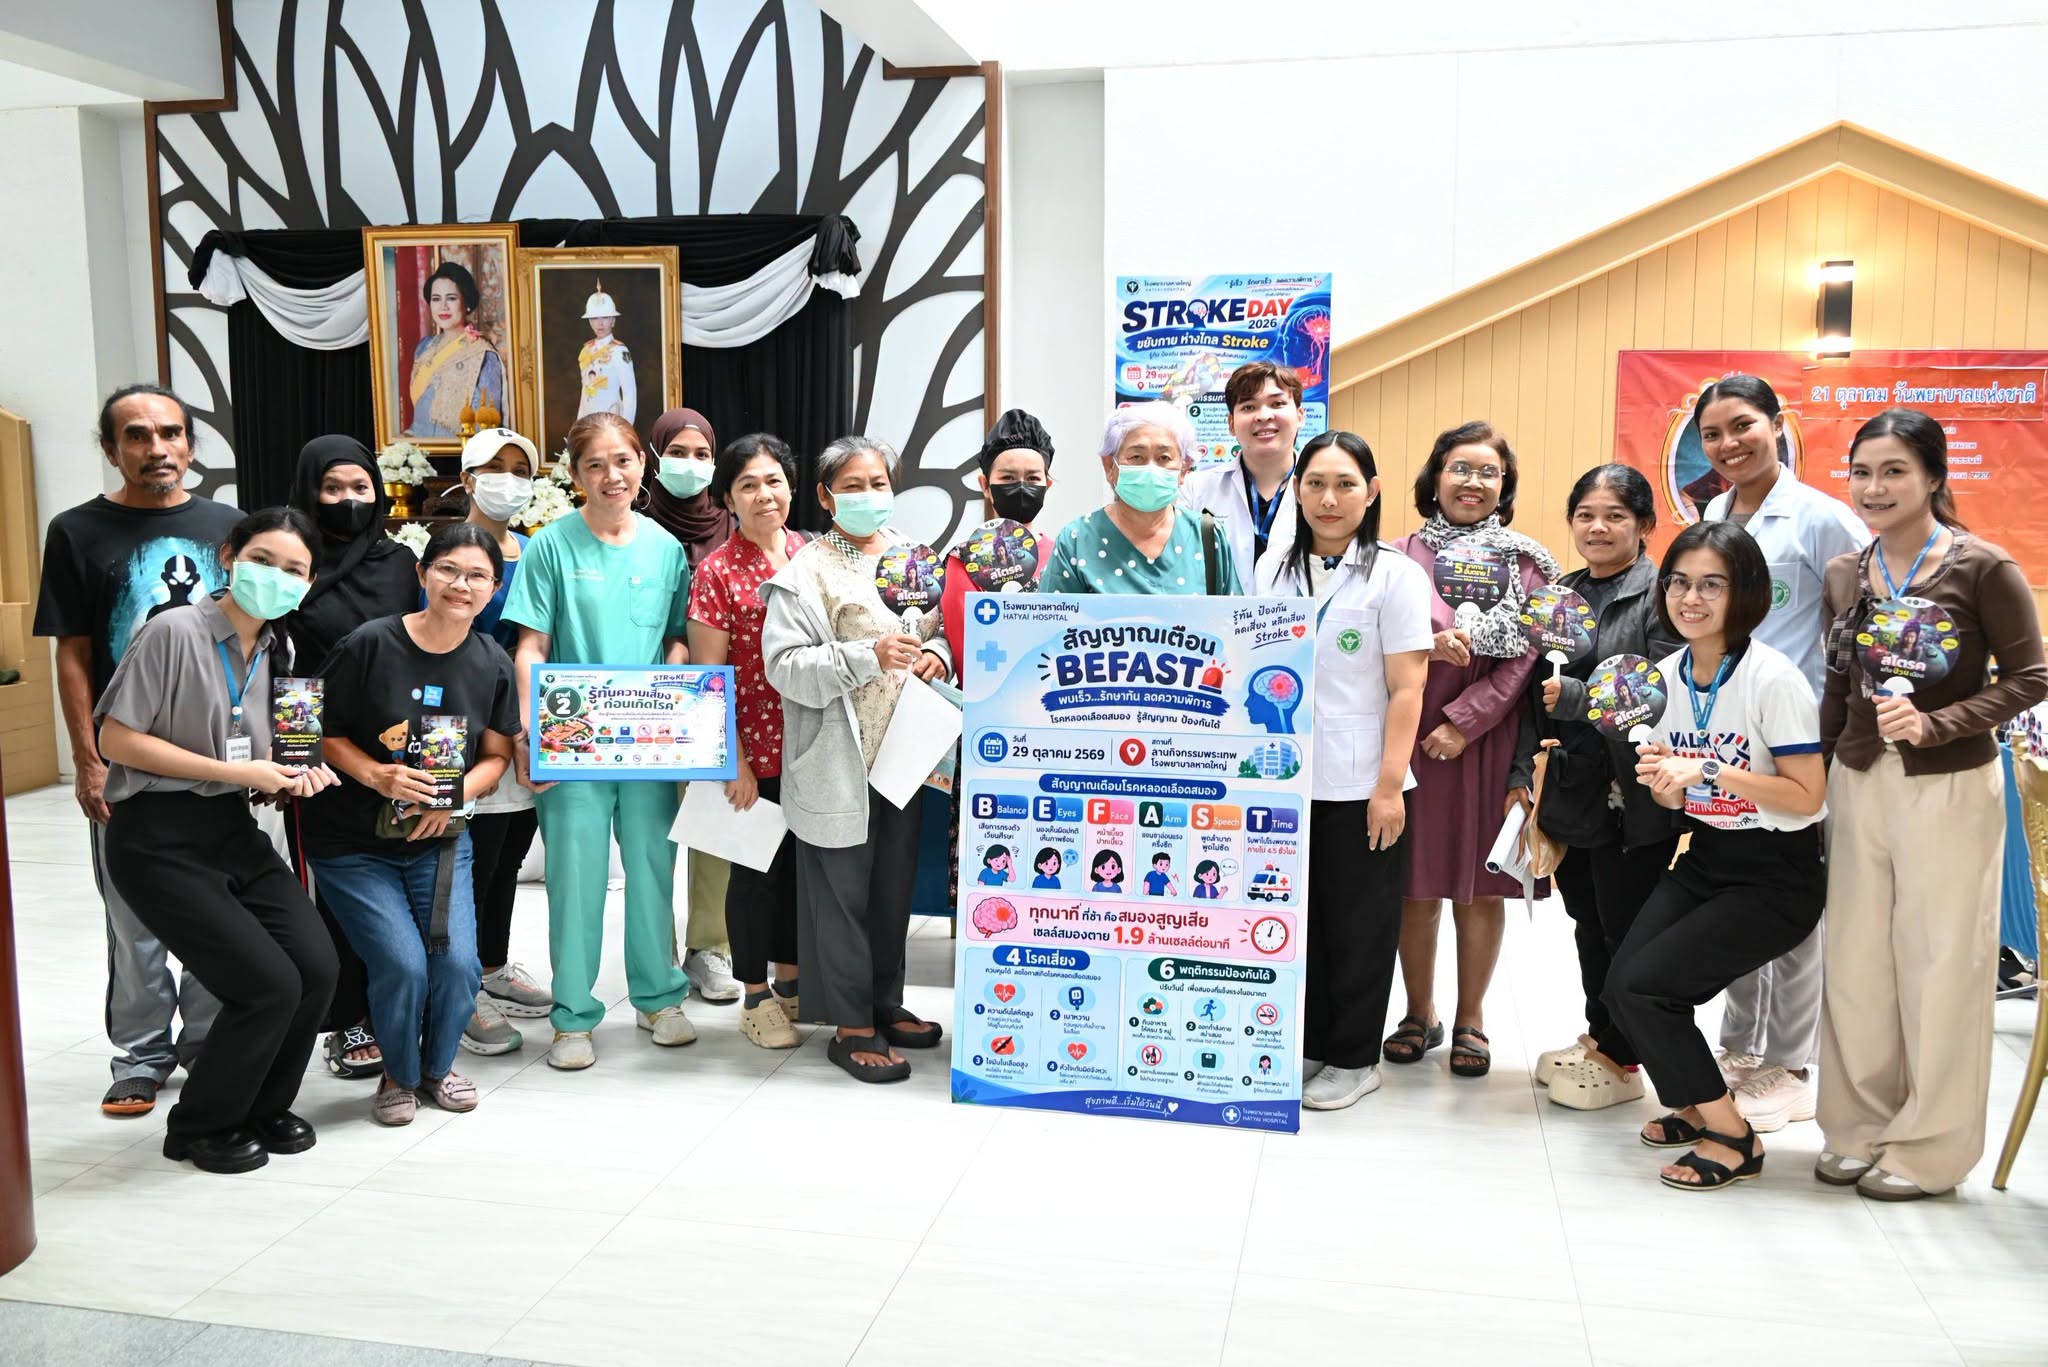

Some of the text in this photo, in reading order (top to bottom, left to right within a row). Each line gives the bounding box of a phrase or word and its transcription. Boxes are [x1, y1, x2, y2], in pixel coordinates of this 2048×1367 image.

[1247, 298, 1294, 318] DAY
[1248, 318, 1277, 330] 2026
[1137, 331, 1269, 349] ขยับกาย ห่างไกล Stroke
[1145, 371, 1157, 379] 29
[1811, 381, 2037, 410] 21 ตุลาคม วันพยาบาลแห่งชาติ
[1192, 408, 1198, 416] 2
[1454, 562, 1463, 574] 5
[1003, 601, 1080, 613] โรงพยาบาลหาดใหญ่
[1233, 602, 1288, 626] รู้ทัน ป้องกัน
[1032, 613, 1068, 622] HOSPITAL
[1234, 611, 1306, 636] ลดเสี่ยง หลีกเสี่ยง
[1063, 625, 1216, 657] สัญญาณเตือน
[1254, 628, 1289, 644] Stroke
[1055, 651, 1204, 688] BEFAST
[588, 685, 672, 704] รู้ทันความเสี่ยง
[1058, 689, 1213, 710] พบเร็ว...รักษาทัน ลดความพิการ
[555, 697, 571, 715] 2
[603, 697, 674, 711] ก่อนเกิดโรค
[1050, 710, 1222, 730] โรคหลอดเลือดสมอง รู้สัญญาณ ป้องกันได้
[1012, 733, 1027, 743] วันที่
[1151, 737, 1173, 746] สถานที่
[1012, 746, 1105, 762] 29 ตุลาคม 2569
[1151, 747, 1237, 760] ลานกิจกรรมพระเทพ
[1151, 758, 1228, 771] โรงพยาบาลหาดใหญ่
[1051, 777, 1217, 796] สัญญาณเตือนโรคหลอดเลือดสมอง
[978, 797, 1027, 816] B Balance
[1039, 799, 1077, 819] E Eyes
[1093, 802, 1129, 821] F Face
[1143, 805, 1182, 825] A Arm
[1196, 807, 1240, 827] S Speech
[1251, 810, 1294, 830] T Time
[1118, 911, 1209, 930] สมองสูญเสีย
[1033, 926, 1230, 950] เซลล์สมองตาย 1.9 ล้านเซลล์ต่อนาที
[1006, 947, 1076, 967] 4 โรคเสี่ยง
[1159, 959, 1271, 981] 6 พฤติกรรมป้องกันได้
[977, 1005, 982, 1013] 1
[1052, 1011, 1058, 1019] 2
[1132, 1018, 1136, 1026] 1
[1188, 1022, 1194, 1030] 2
[1247, 1027, 1252, 1035] 3
[975, 1056, 981, 1064] 3
[1049, 1062, 1056, 1070] 4
[1129, 1067, 1136, 1075] 4
[1186, 1072, 1192, 1080] 5
[1244, 1077, 1250, 1085] 6
